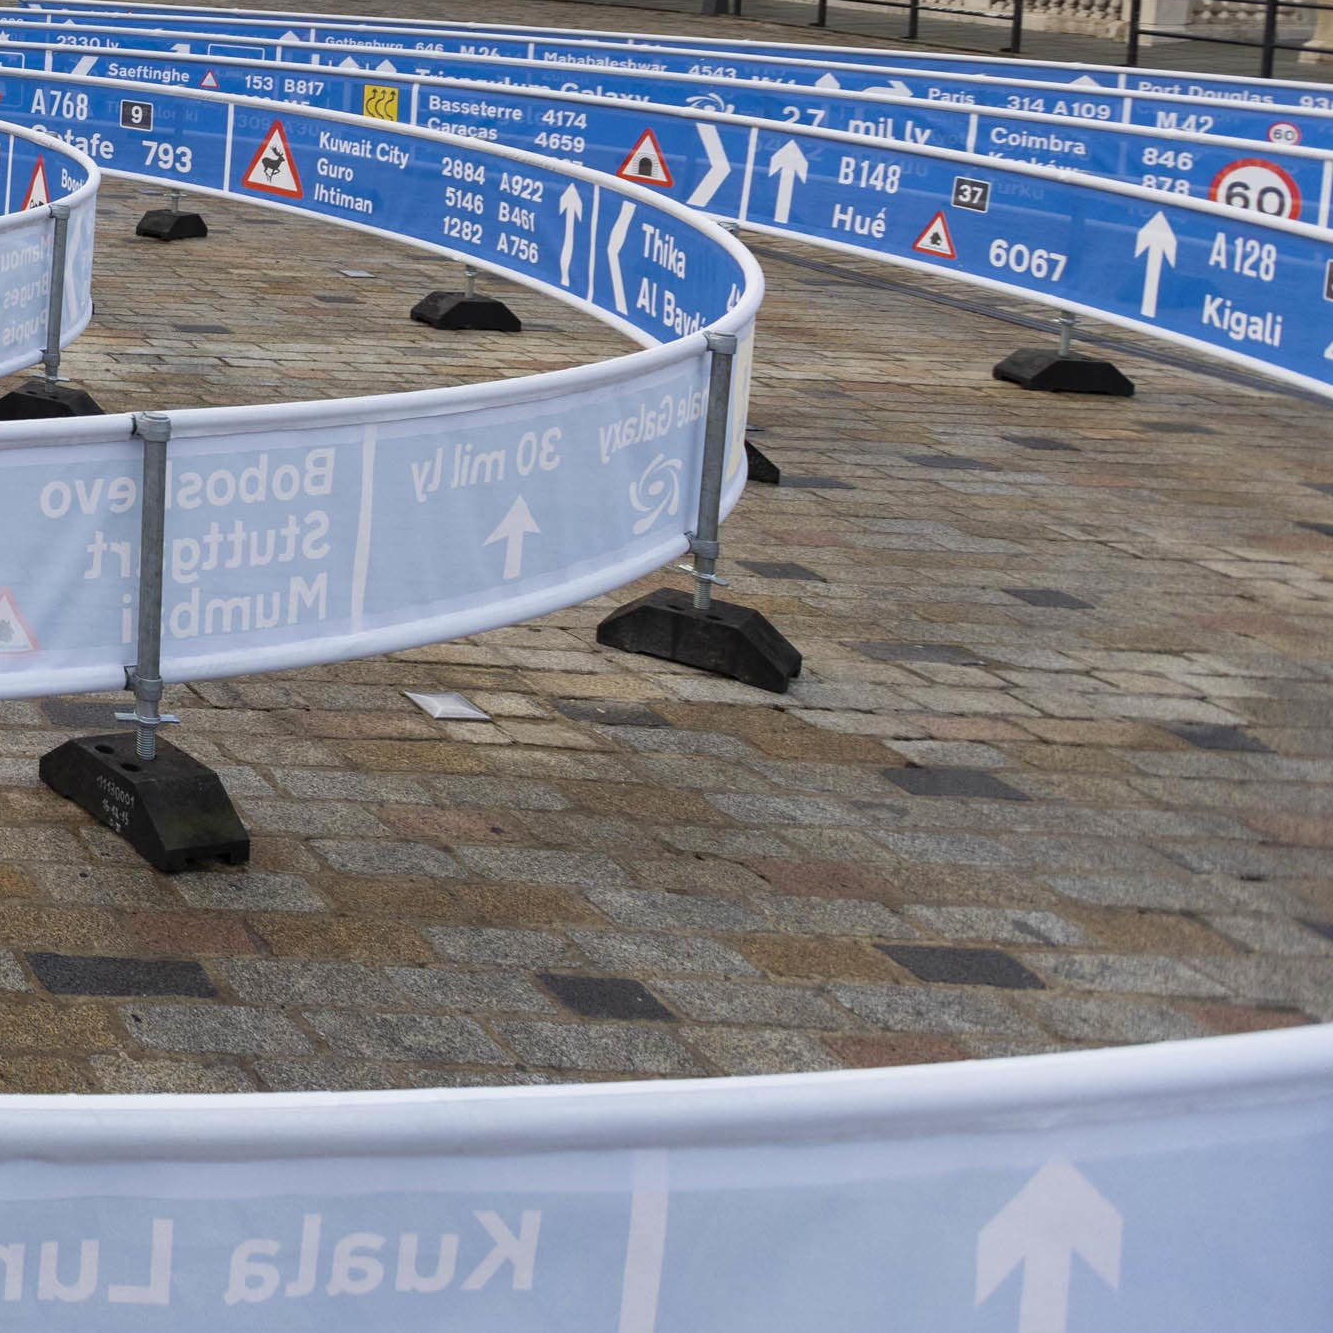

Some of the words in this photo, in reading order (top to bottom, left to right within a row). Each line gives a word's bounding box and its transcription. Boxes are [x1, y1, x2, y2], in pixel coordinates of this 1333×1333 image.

[108, 63, 190, 83] Saeftinghe
[245, 75, 274, 91] 153
[284, 78, 324, 96] B817
[543, 51, 668, 72] Mahabaleshwar
[688, 64, 737, 79] 4543
[31, 88, 89, 120] A768
[131, 106, 143, 123] 9
[429, 95, 523, 120] Basseterre
[541, 109, 587, 129] 4174
[928, 88, 975, 105] Paris
[1007, 95, 1045, 113] 314
[1053, 100, 1111, 119] A109
[534, 132, 585, 153] 4659
[990, 127, 1087, 155] Coimbra
[1273, 130, 1295, 140] 60
[142, 141, 192, 173] 793
[319, 131, 372, 158] Kuwait
[376, 142, 410, 169] City
[442, 157, 485, 185] 2884
[500, 172, 544, 202] A922
[1142, 148, 1194, 170] 846
[838, 156, 901, 194] B148
[1142, 174, 1190, 196] 878
[317, 157, 354, 182] Guro
[445, 187, 484, 214] 5146
[498, 202, 536, 232] B461
[958, 185, 983, 204] 37
[1225, 181, 1287, 216] 60
[314, 183, 373, 214] Ihtiman
[443, 216, 483, 245] 1282
[497, 232, 539, 264] A756
[642, 223, 686, 280] Thika
[989, 239, 1068, 282] 6067
[1208, 232, 1277, 282] A128
[636, 277, 657, 317] Al
[1202, 294, 1282, 347] Kigali
